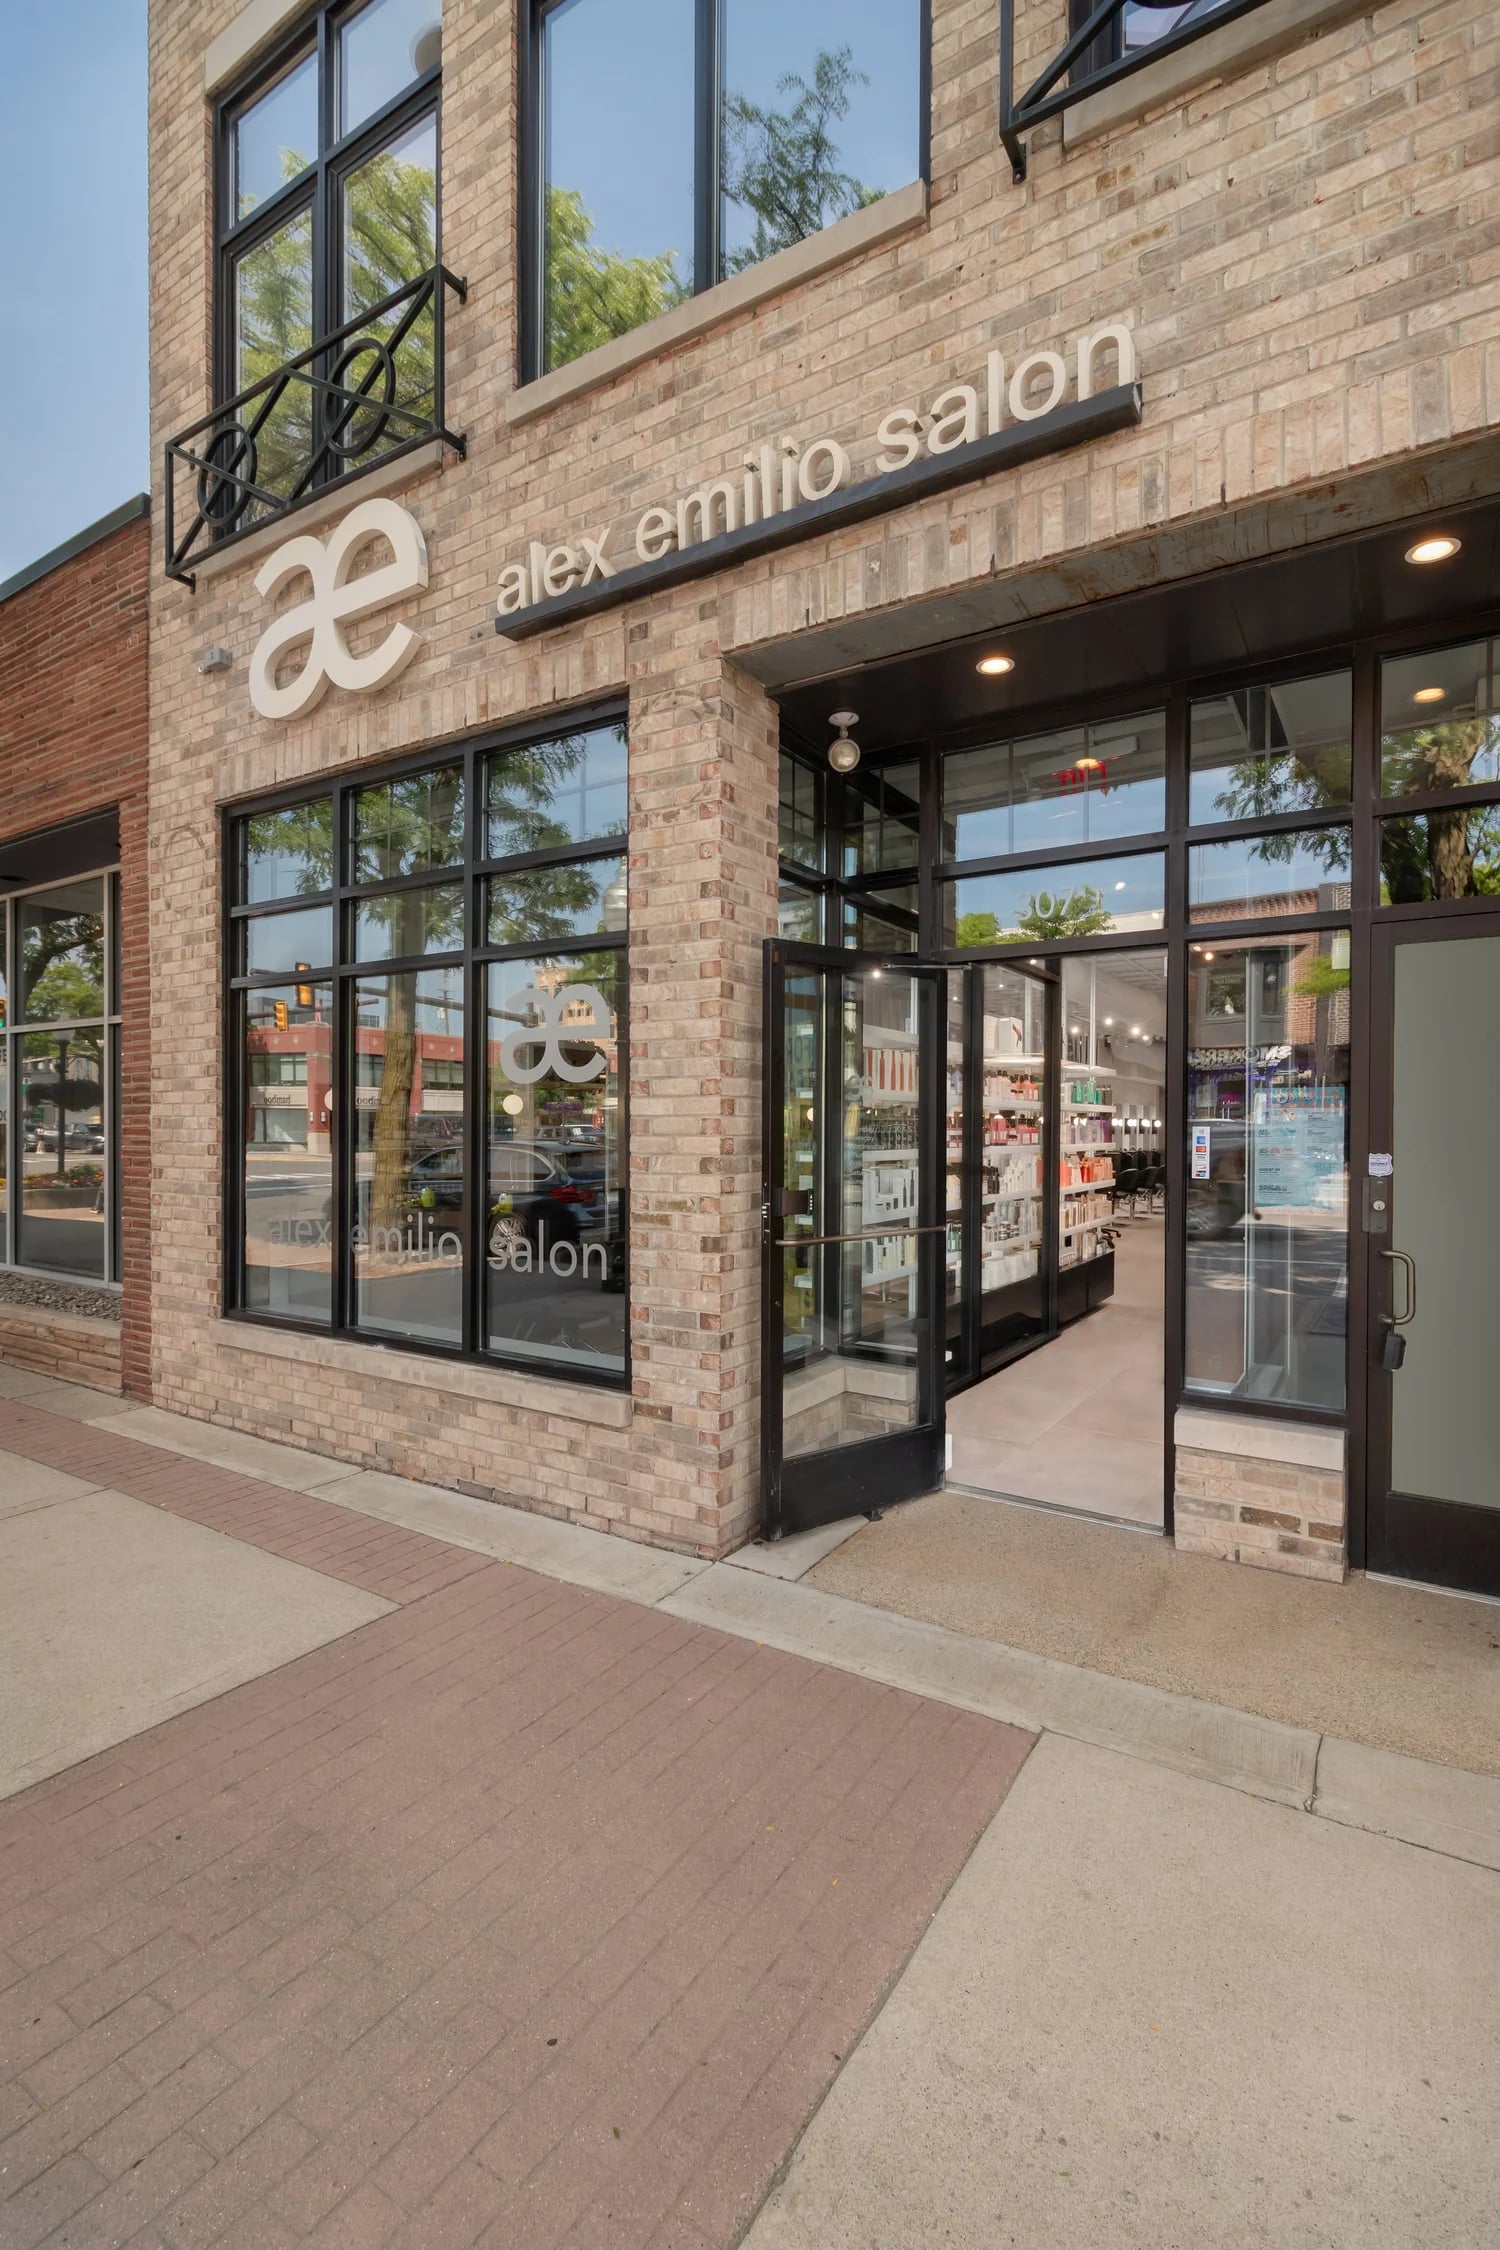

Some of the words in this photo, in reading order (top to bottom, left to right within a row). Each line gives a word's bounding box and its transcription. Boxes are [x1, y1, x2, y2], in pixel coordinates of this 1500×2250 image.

[497, 527, 618, 615] alex
[635, 437, 851, 562] emilio
[875, 324, 1136, 473] salon
[1015, 885, 1077, 921] 307
[270, 1207, 333, 1248] alex
[350, 1211, 462, 1265] emilio
[488, 1219, 608, 1281] salon
